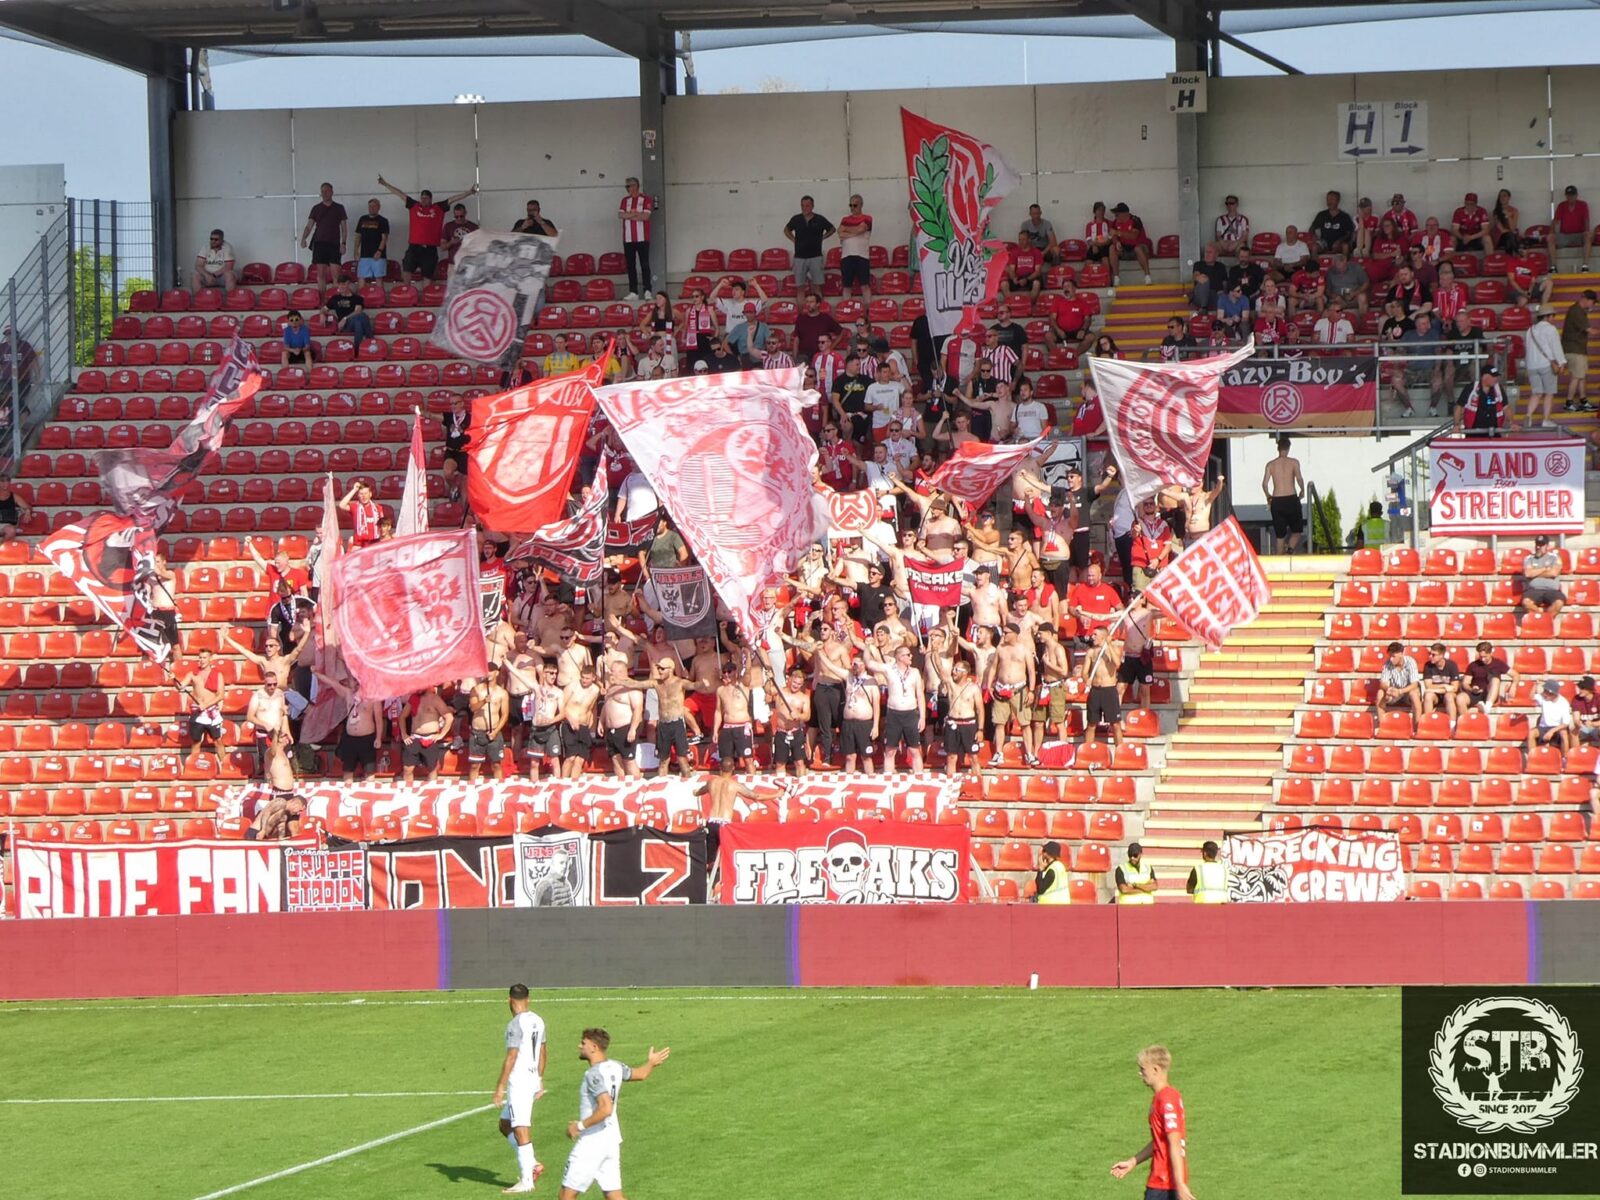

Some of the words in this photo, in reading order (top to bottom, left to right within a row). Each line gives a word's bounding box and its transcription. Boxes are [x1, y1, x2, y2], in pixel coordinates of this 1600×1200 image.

[1172, 76, 1200, 85] Block
[1177, 89, 1195, 108] H
[1348, 103, 1372, 111] Block
[1394, 102, 1418, 110] Block
[1345, 111, 1375, 144] H
[1474, 451, 1538, 480] LAND
[1440, 489, 1574, 520] STREICHER
[1230, 830, 1399, 872] WRECKING
[287, 877, 365, 906] STADION
[1289, 869, 1380, 902] CREW
